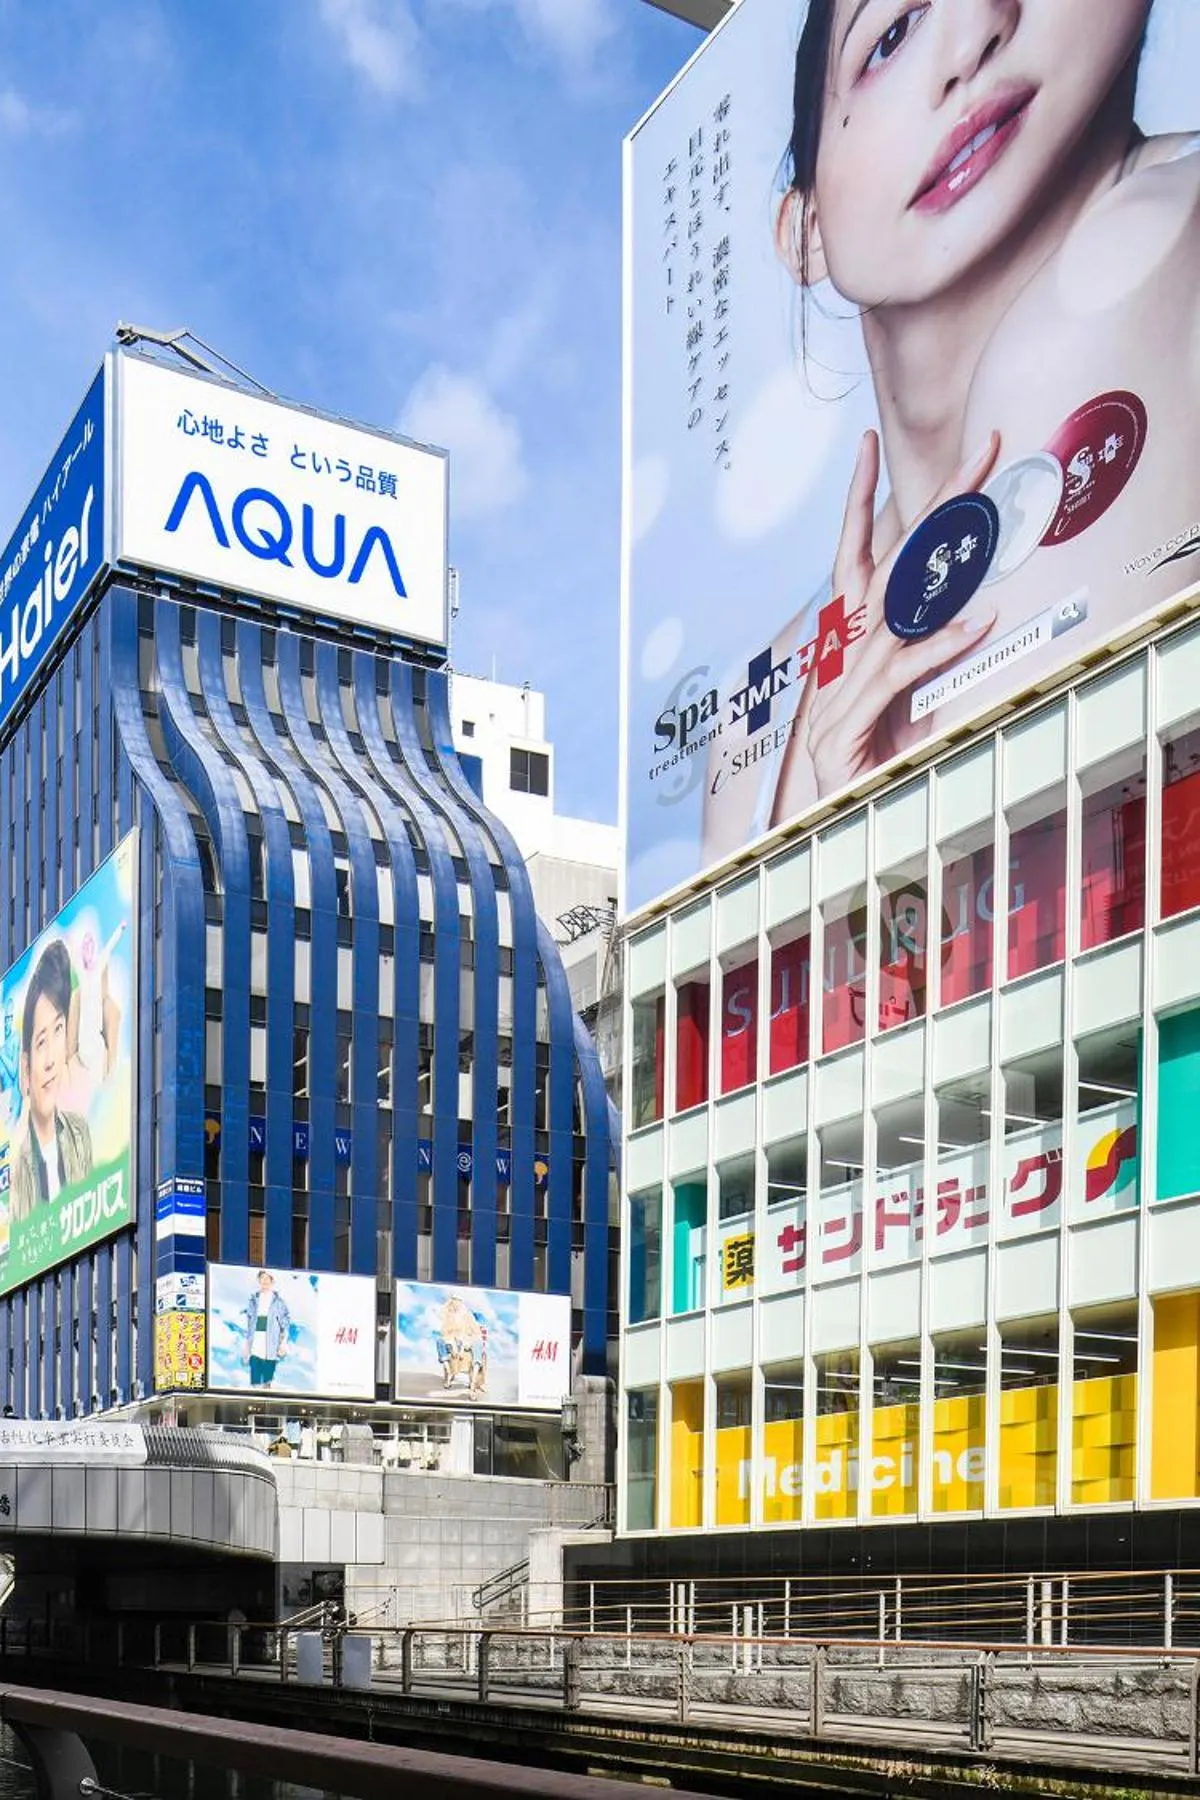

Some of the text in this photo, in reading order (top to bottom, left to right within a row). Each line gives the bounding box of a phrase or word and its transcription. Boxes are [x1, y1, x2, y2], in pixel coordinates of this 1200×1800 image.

[42, 418, 94, 525] ハイアール
[177, 408, 398, 500] 心地よさ という品質
[164, 471, 407, 599] AQUA
[729, 656, 793, 725] NMN
[917, 626, 1040, 711] spa-treatment
[649, 722, 723, 780] treatment
[654, 688, 719, 754] Spa
[732, 715, 801, 776] SHEET
[60, 1168, 127, 1246] サロンパス
[777, 1147, 1063, 1274] サンドラッグ
[727, 1236, 755, 1287] 薬
[738, 1442, 985, 1499] Medicine
